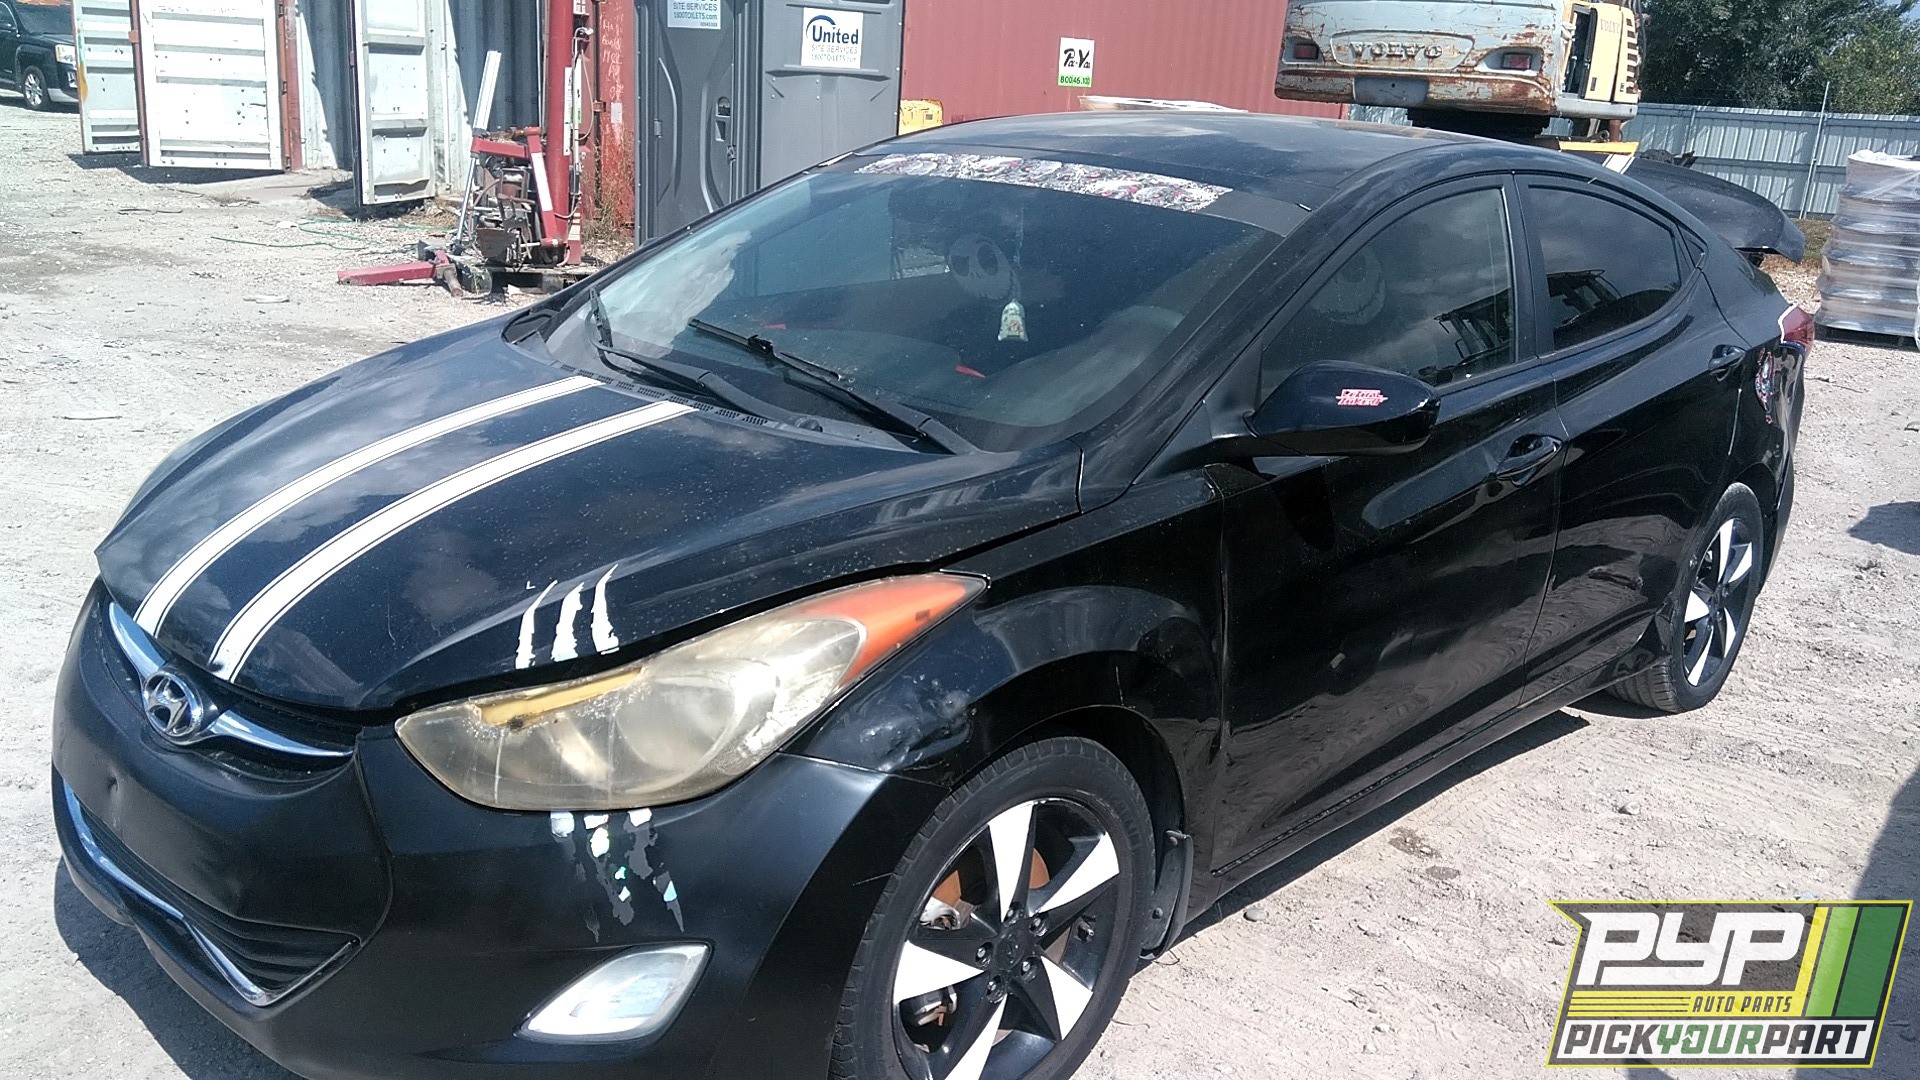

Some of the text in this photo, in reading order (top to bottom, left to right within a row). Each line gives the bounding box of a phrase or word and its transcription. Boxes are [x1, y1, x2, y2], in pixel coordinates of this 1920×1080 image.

[673, 2, 718, 12] SITE SERVICES
[812, 24, 859, 45] United
[811, 44, 858, 54] SITE SERVICES
[1348, 41, 1443, 59] VOLVO
